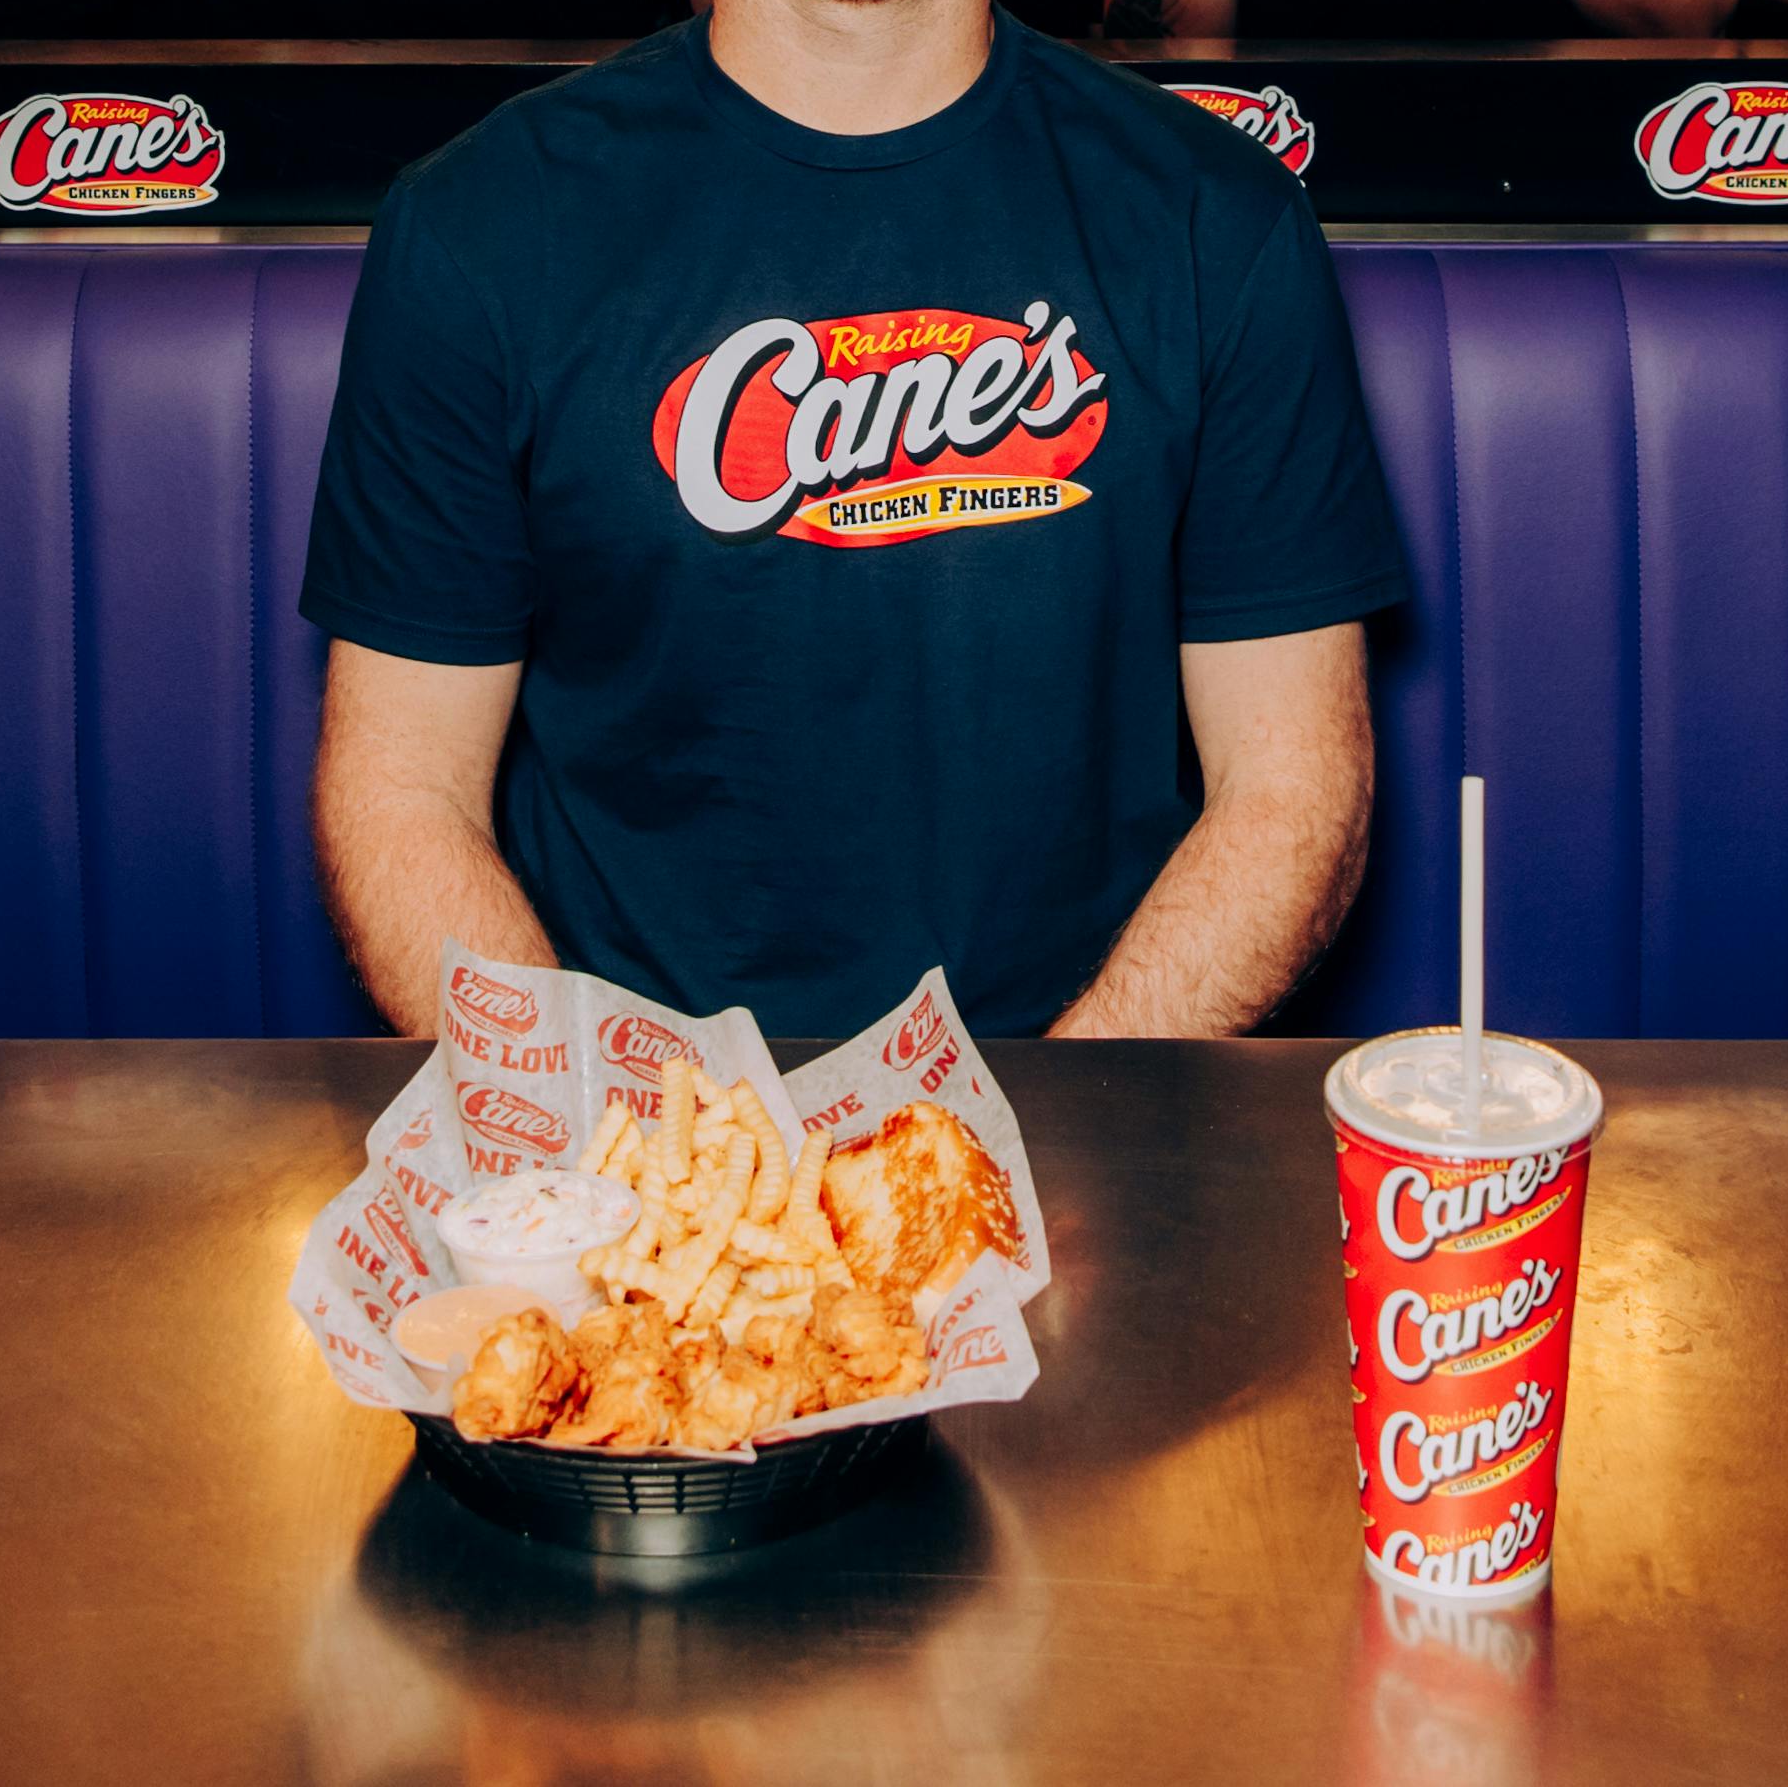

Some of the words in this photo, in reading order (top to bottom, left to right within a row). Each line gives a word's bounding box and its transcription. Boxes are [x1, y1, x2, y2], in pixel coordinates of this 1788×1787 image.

[71, 103, 149, 124] Raising
[69, 187, 130, 199] CHICKEN
[136, 187, 196, 199] FINGERS
[1726, 176, 1787, 189] CHICKEN
[828, 315, 974, 368] Raising
[675, 300, 1106, 533] Cane's
[829, 493, 927, 527] CHICKEN
[939, 482, 1059, 513] FINGERS
[445, 1008, 493, 1061] ONE
[459, 1083, 571, 1142] Cane's
[1454, 1226, 1513, 1251] CHICKEN
[1430, 1281, 1504, 1312] Raising
[1377, 1258, 1561, 1382] Cane's
[1451, 1350, 1508, 1374] CHICKEN
[1426, 1404, 1498, 1434] Raising
[1379, 1380, 1552, 1502] Cane's
[1448, 1470, 1502, 1494] CHICKEN
[1381, 1501, 1544, 1587] Cane's
[1426, 1524, 1493, 1553] Raising
